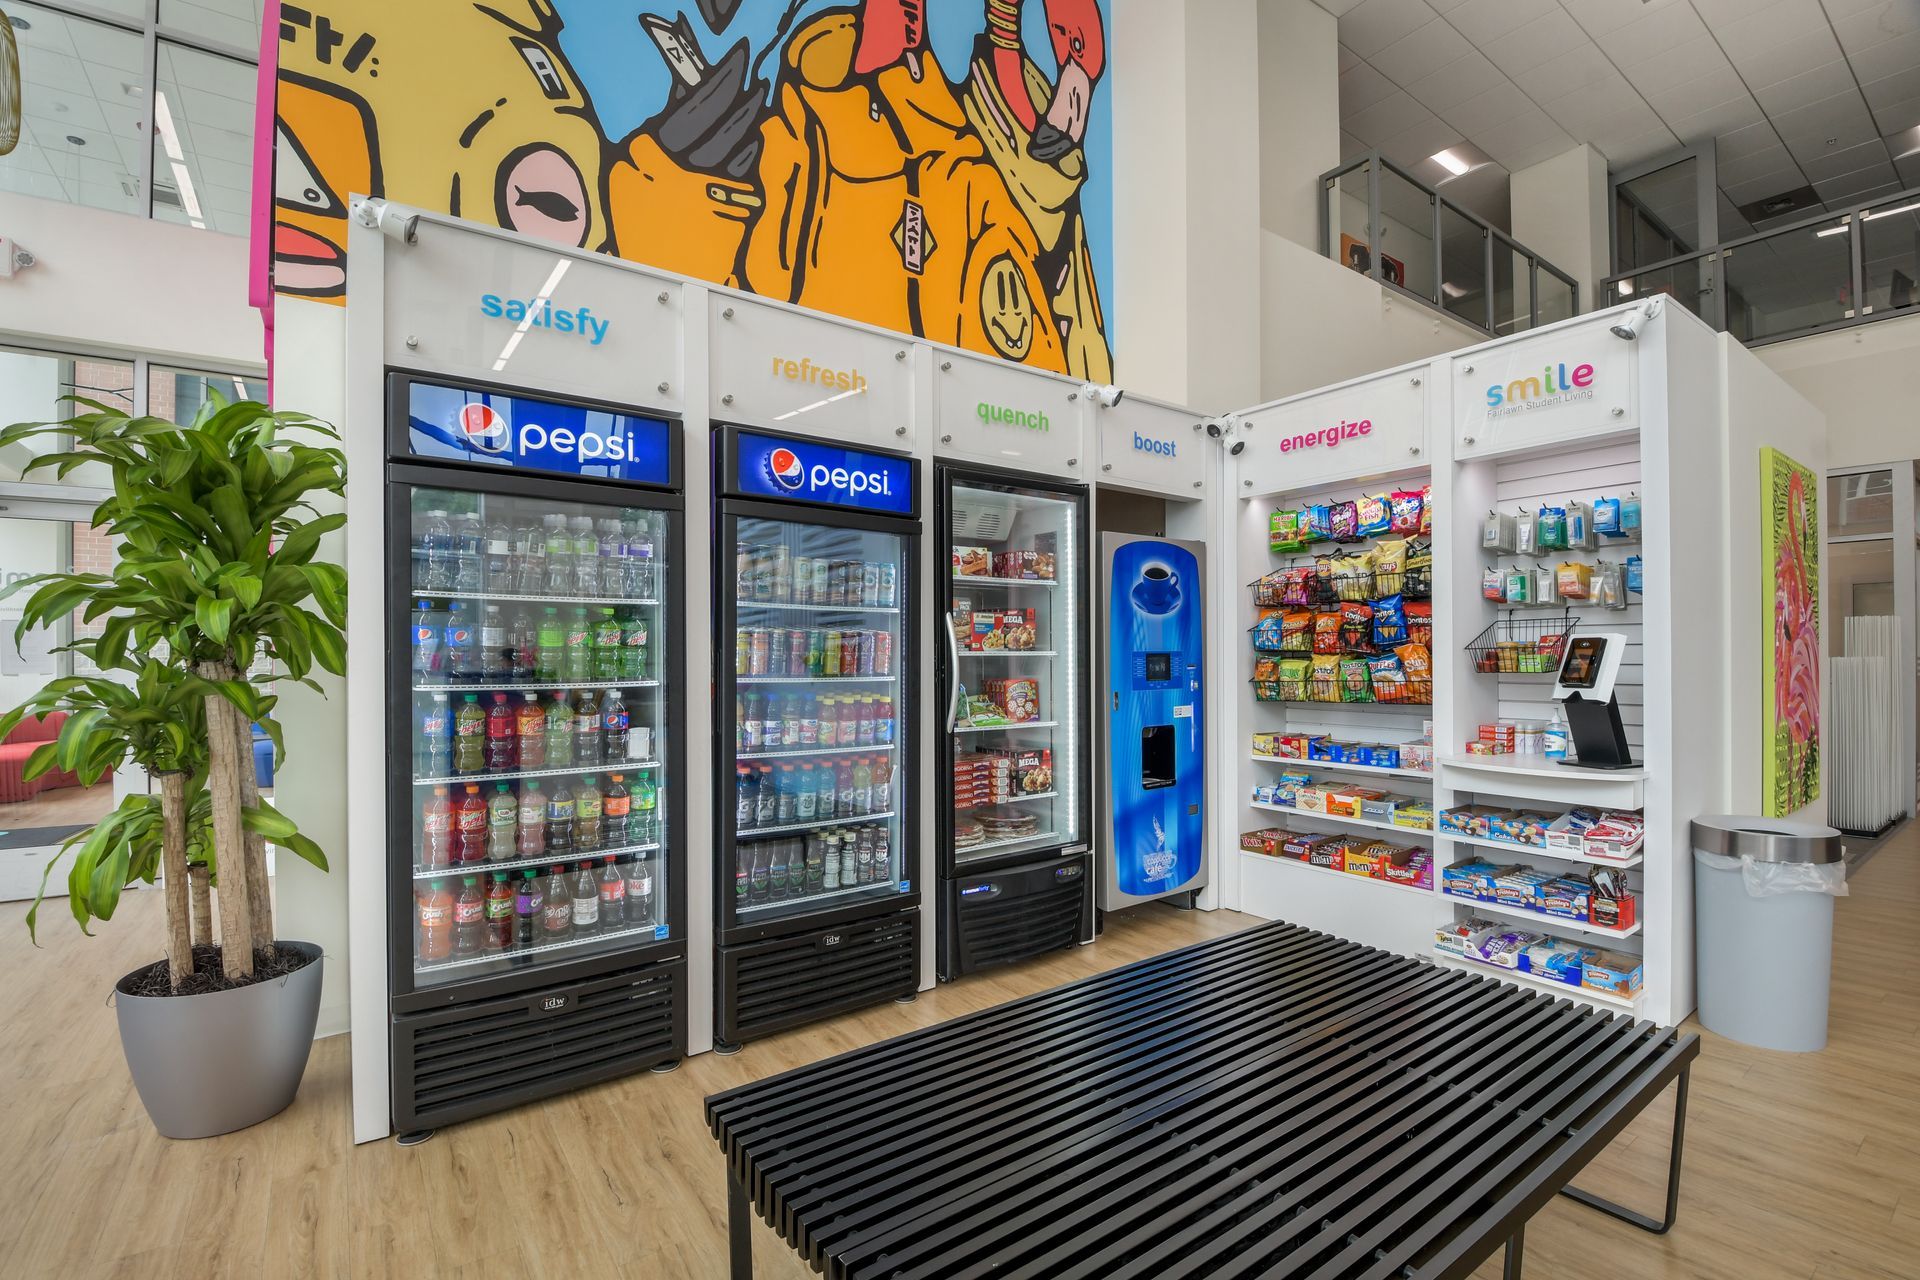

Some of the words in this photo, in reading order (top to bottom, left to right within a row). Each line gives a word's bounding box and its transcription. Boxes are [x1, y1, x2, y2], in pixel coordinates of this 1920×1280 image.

[481, 294, 609, 345] satisfy
[772, 357, 867, 395] refresh
[1487, 363, 1594, 407] smile
[977, 401, 1050, 432] quench
[1487, 403, 1523, 418] Fairlawn
[1526, 396, 1561, 410] Student
[1565, 390, 1593, 402] Living
[520, 424, 634, 463] pepsi
[1134, 431, 1176, 457] boost
[1280, 419, 1372, 452] energize
[811, 465, 888, 497] pepsi
[1018, 757, 1039, 768] MEGA
[1443, 825, 1463, 833] Cakes
[1495, 832, 1516, 841] Cakes
[1387, 868, 1414, 879] Skittles
[826, 935, 840, 944] idw
[545, 996, 565, 1008] idw
